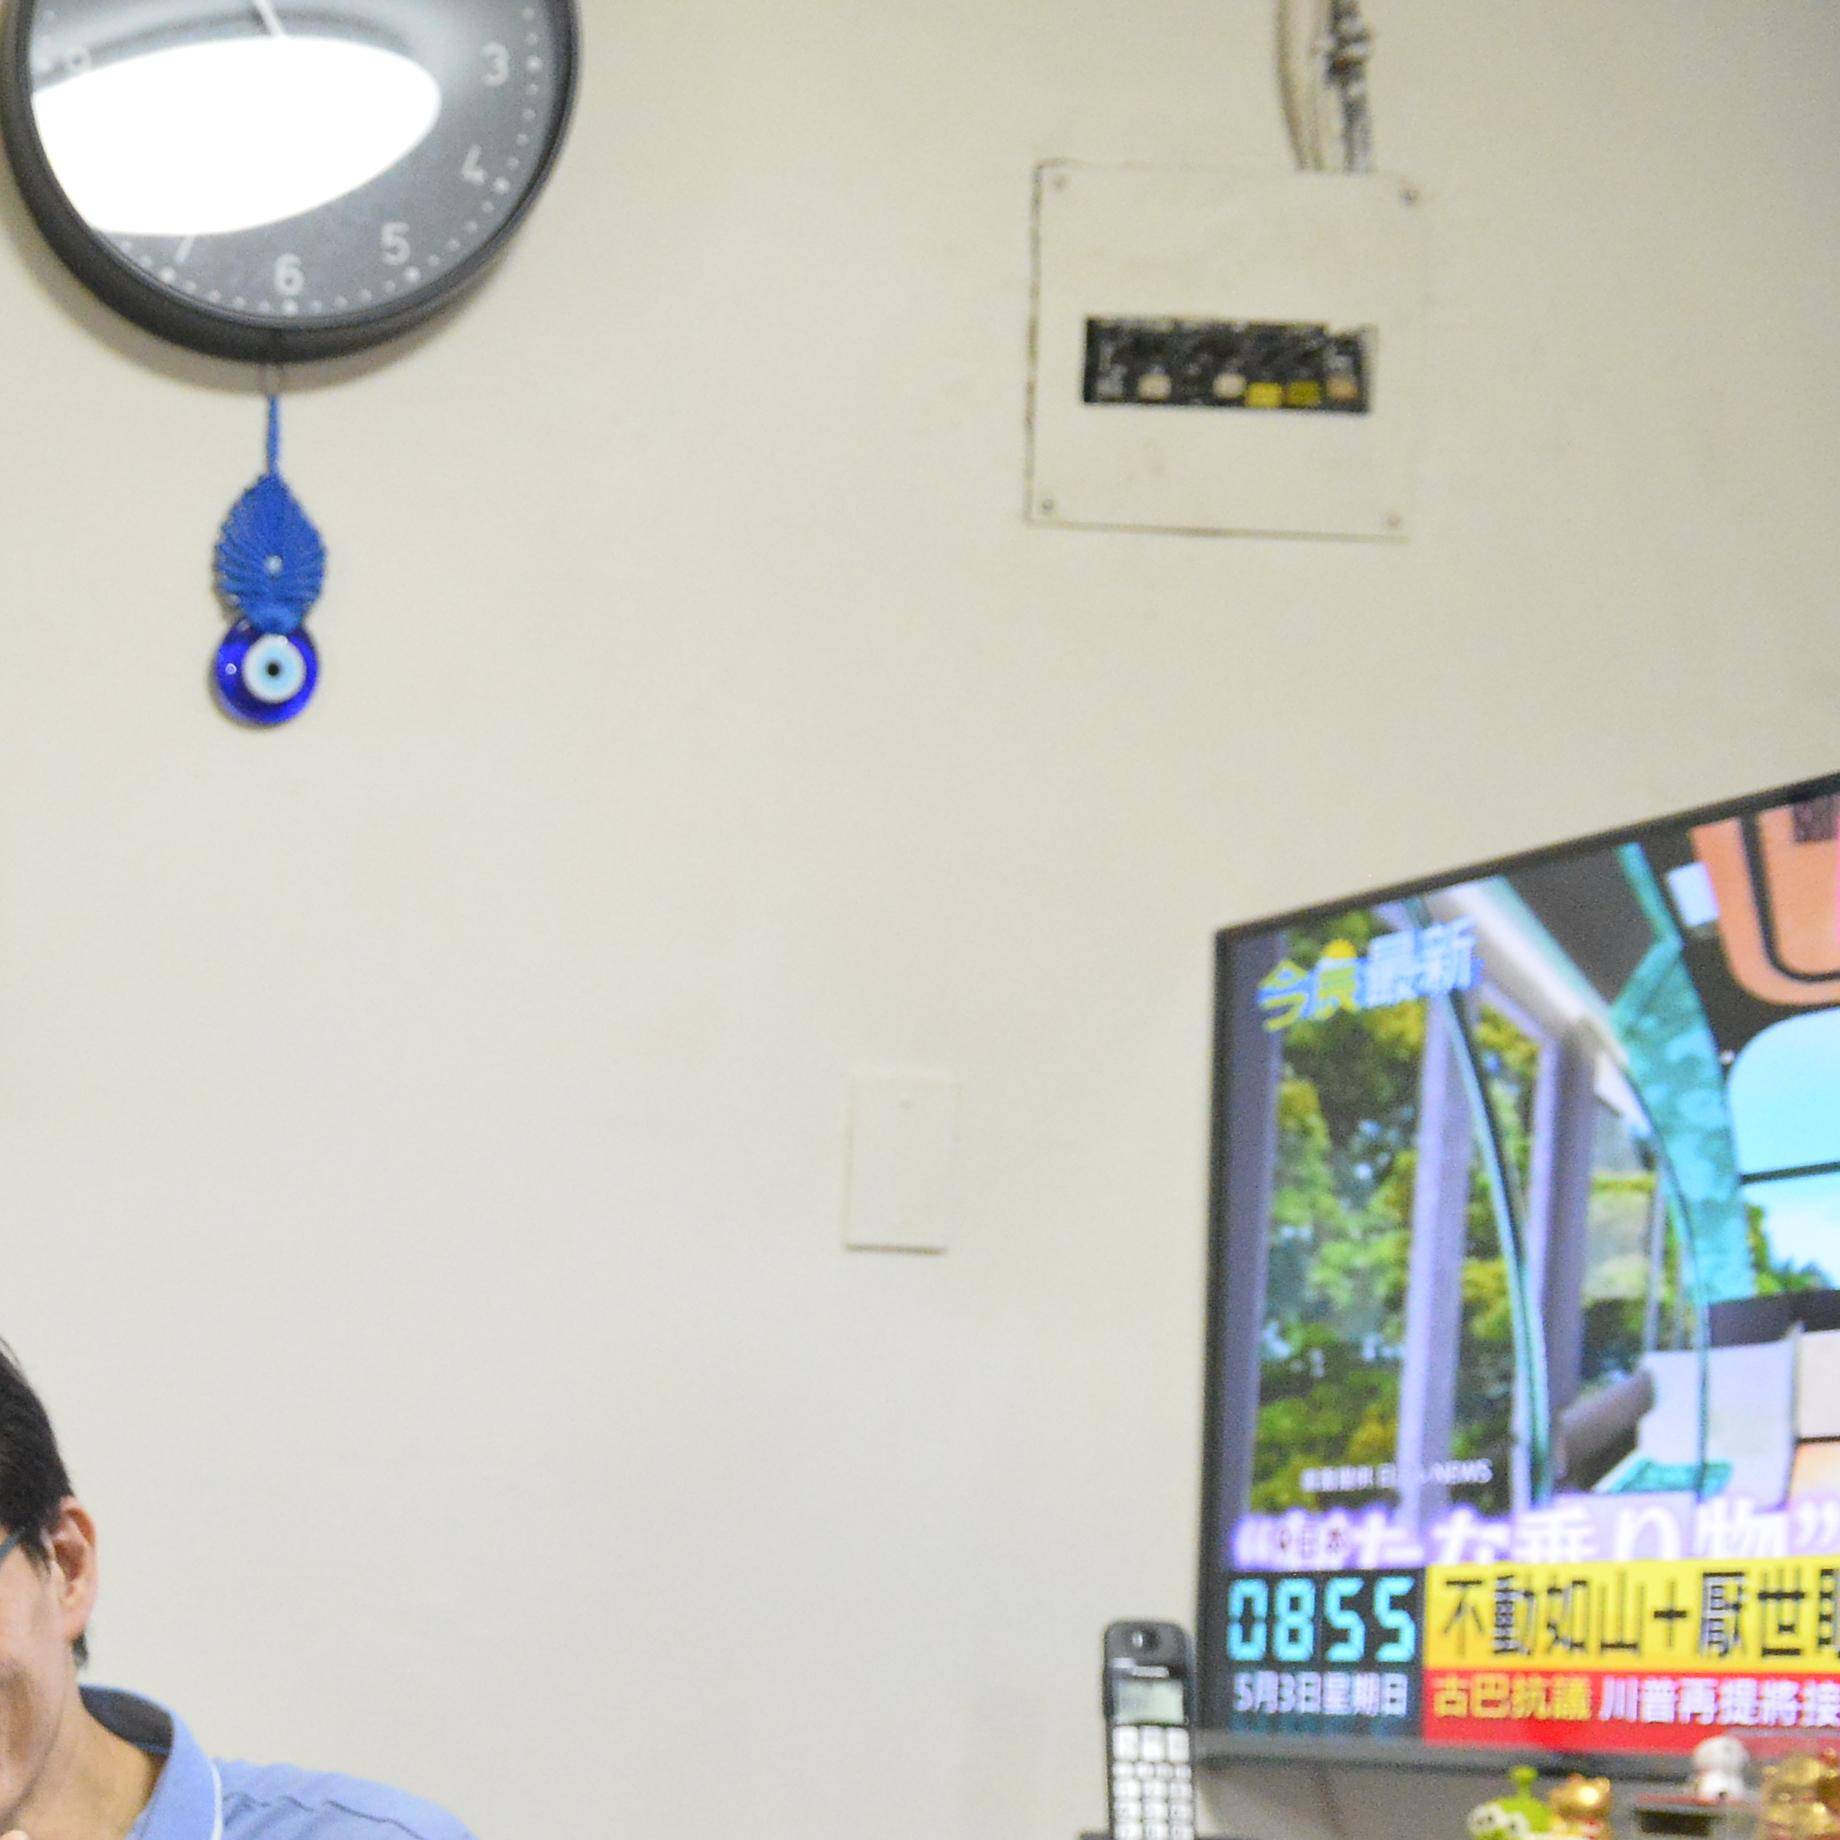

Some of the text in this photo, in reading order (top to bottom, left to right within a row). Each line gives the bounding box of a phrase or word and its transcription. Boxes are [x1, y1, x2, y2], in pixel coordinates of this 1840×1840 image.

[480, 41, 509, 86] 3
[380, 220, 411, 266] 5
[273, 252, 305, 296] 6
[1227, 1575, 1417, 1663] 0855
[1233, 1670, 1409, 1718] 5月3日星期日
[1433, 1671, 1592, 1723] 古巴抗議
